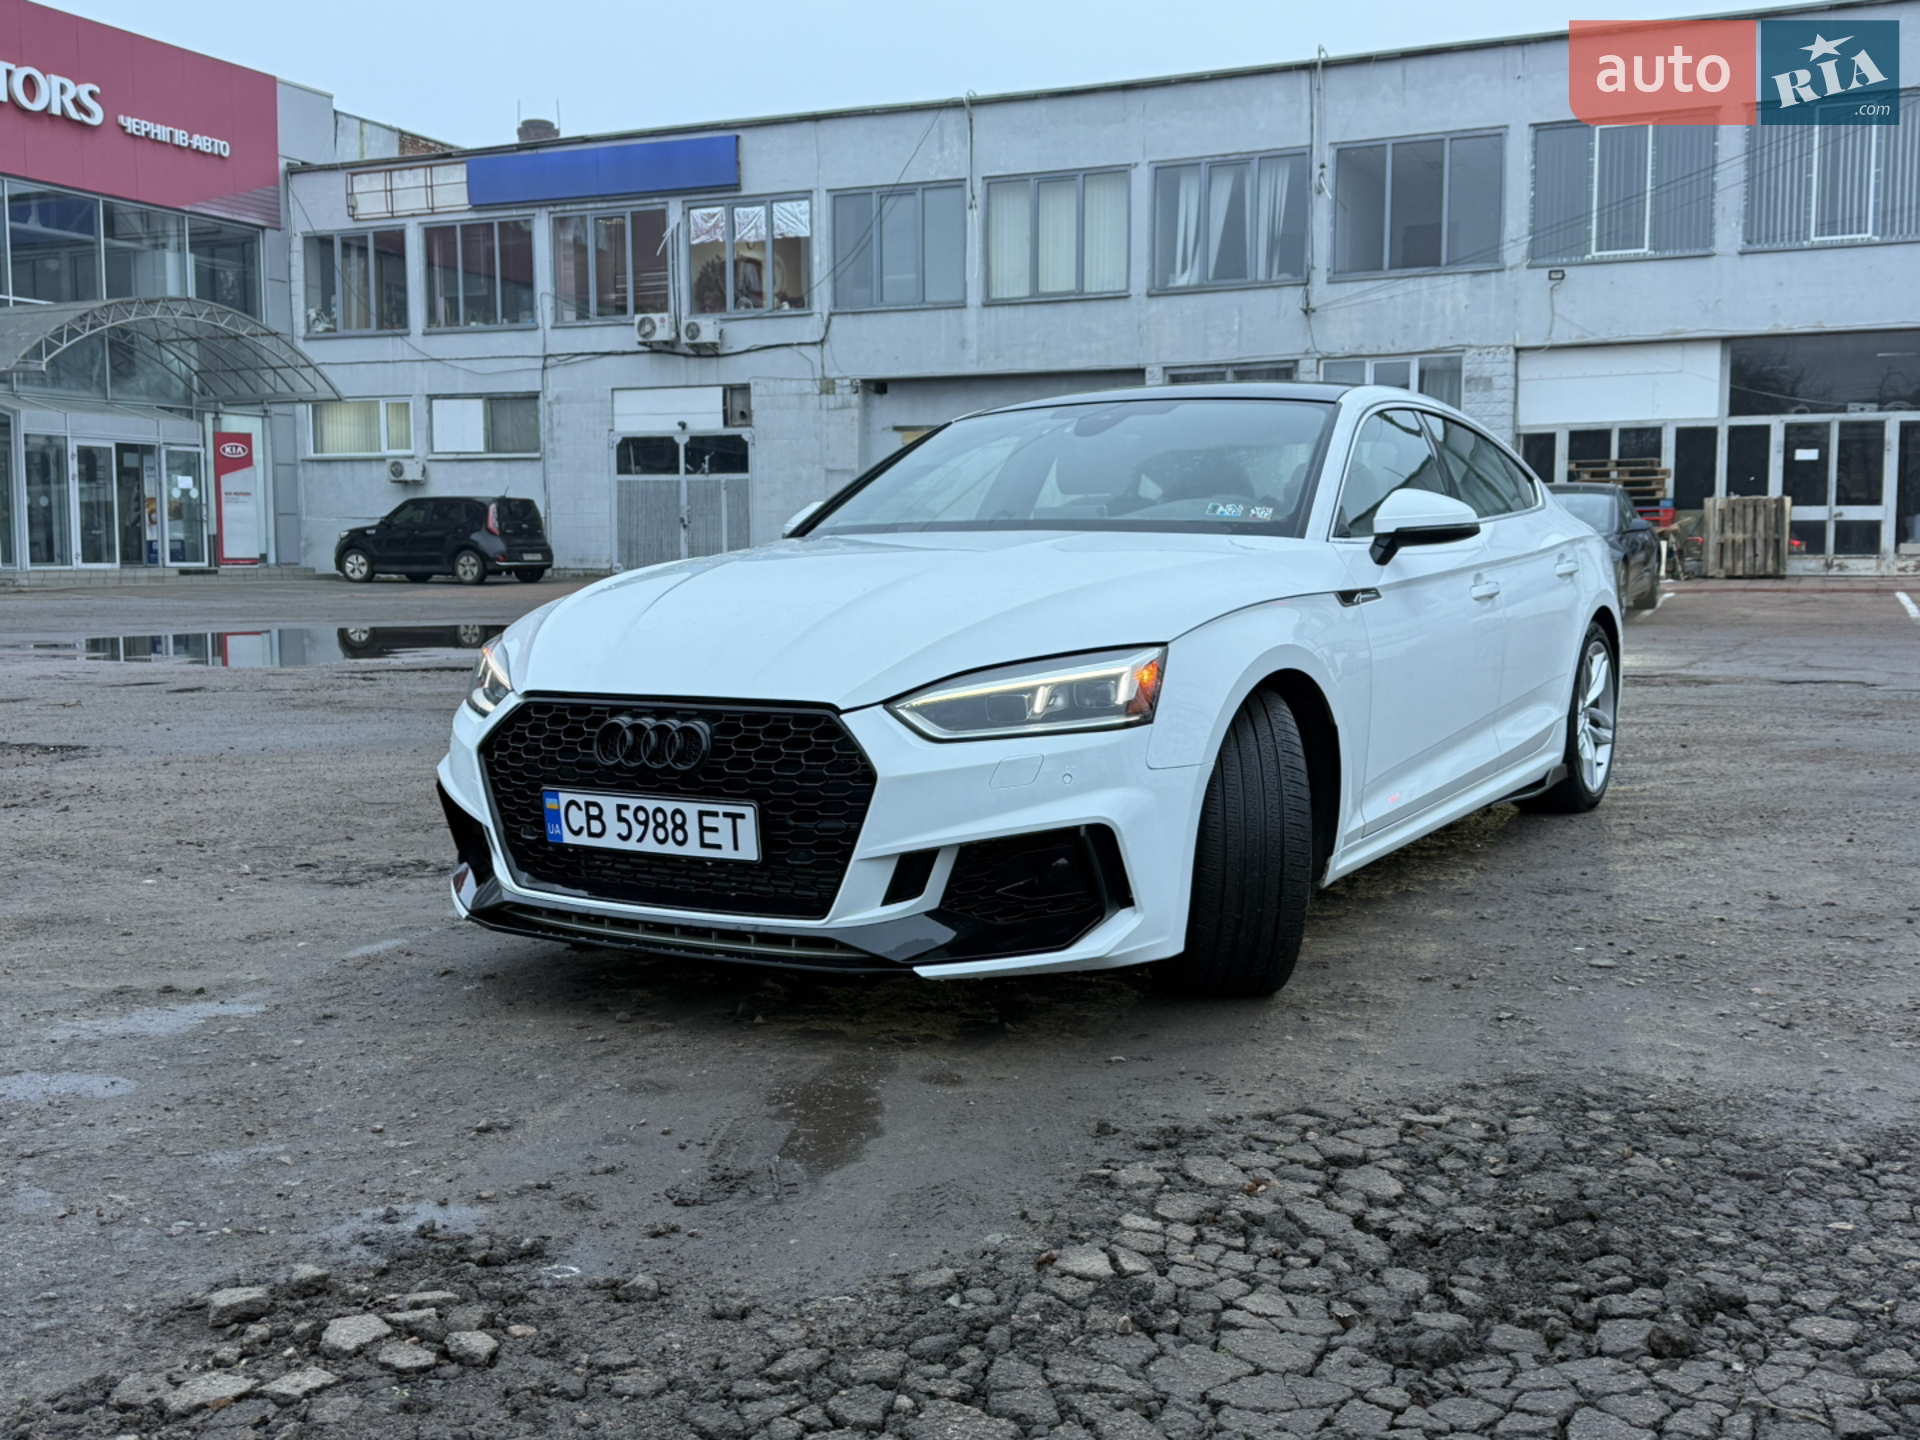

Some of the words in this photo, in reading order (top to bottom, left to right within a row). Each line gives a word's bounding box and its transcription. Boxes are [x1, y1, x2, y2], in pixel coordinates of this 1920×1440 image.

[117, 114, 231, 158] ЧЕРНІГІВ-АВТО
[224, 446, 244, 455] KIA
[547, 822, 562, 836] UA
[564, 799, 607, 839] CB
[616, 803, 689, 847] 5988
[698, 809, 746, 852] ET
